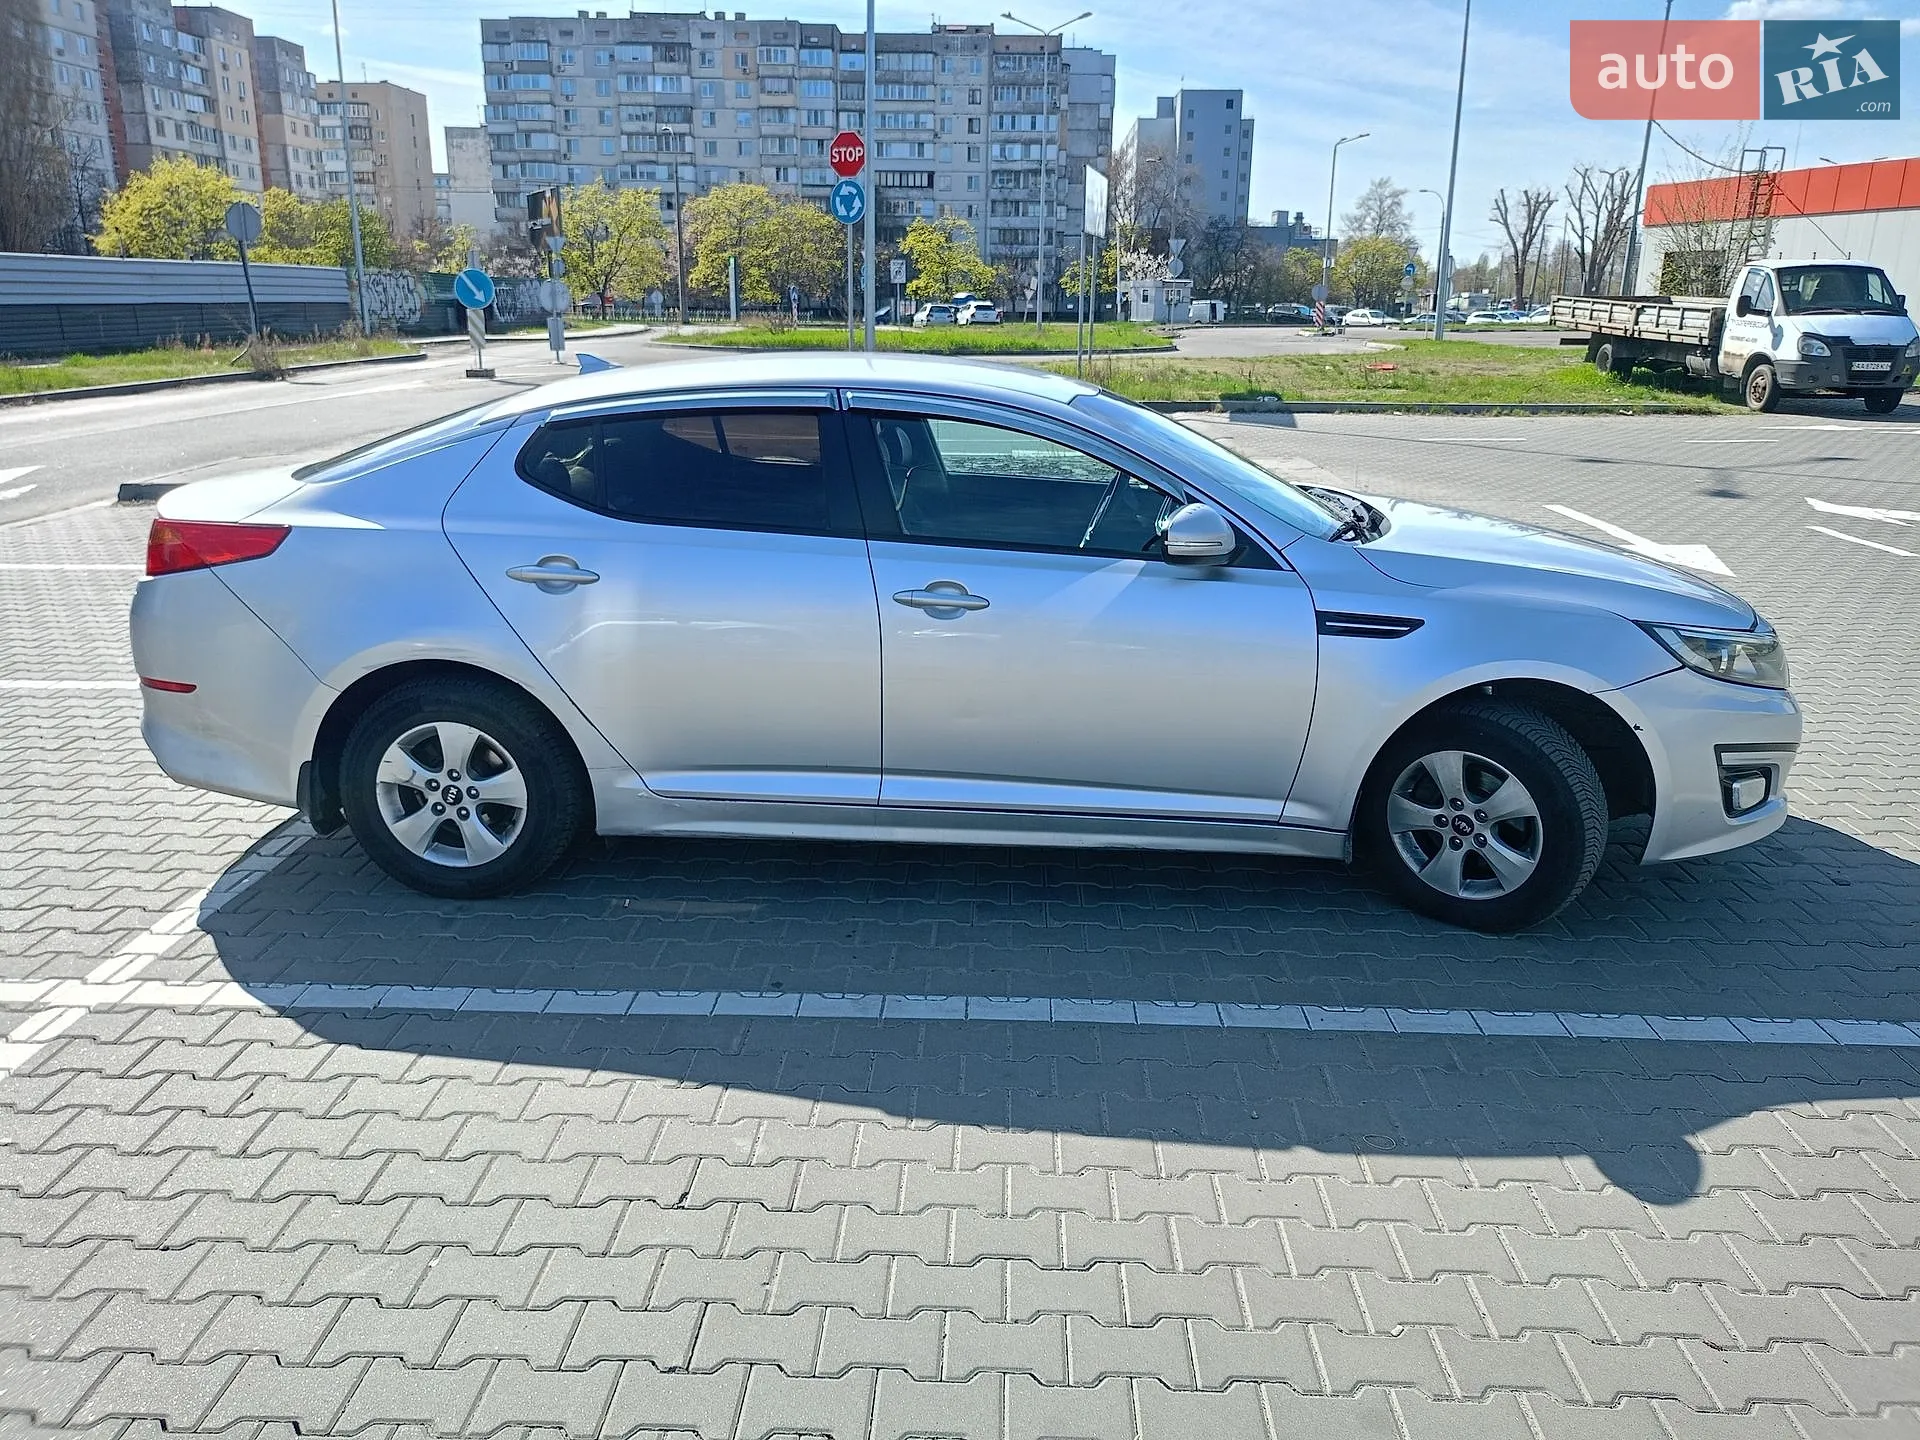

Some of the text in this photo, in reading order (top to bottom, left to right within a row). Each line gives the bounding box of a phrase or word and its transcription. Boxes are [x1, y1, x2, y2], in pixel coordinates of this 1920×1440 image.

[832, 147, 864, 163] STOP
[446, 787, 458, 803] KIA
[1455, 818, 1472, 833] KIA
